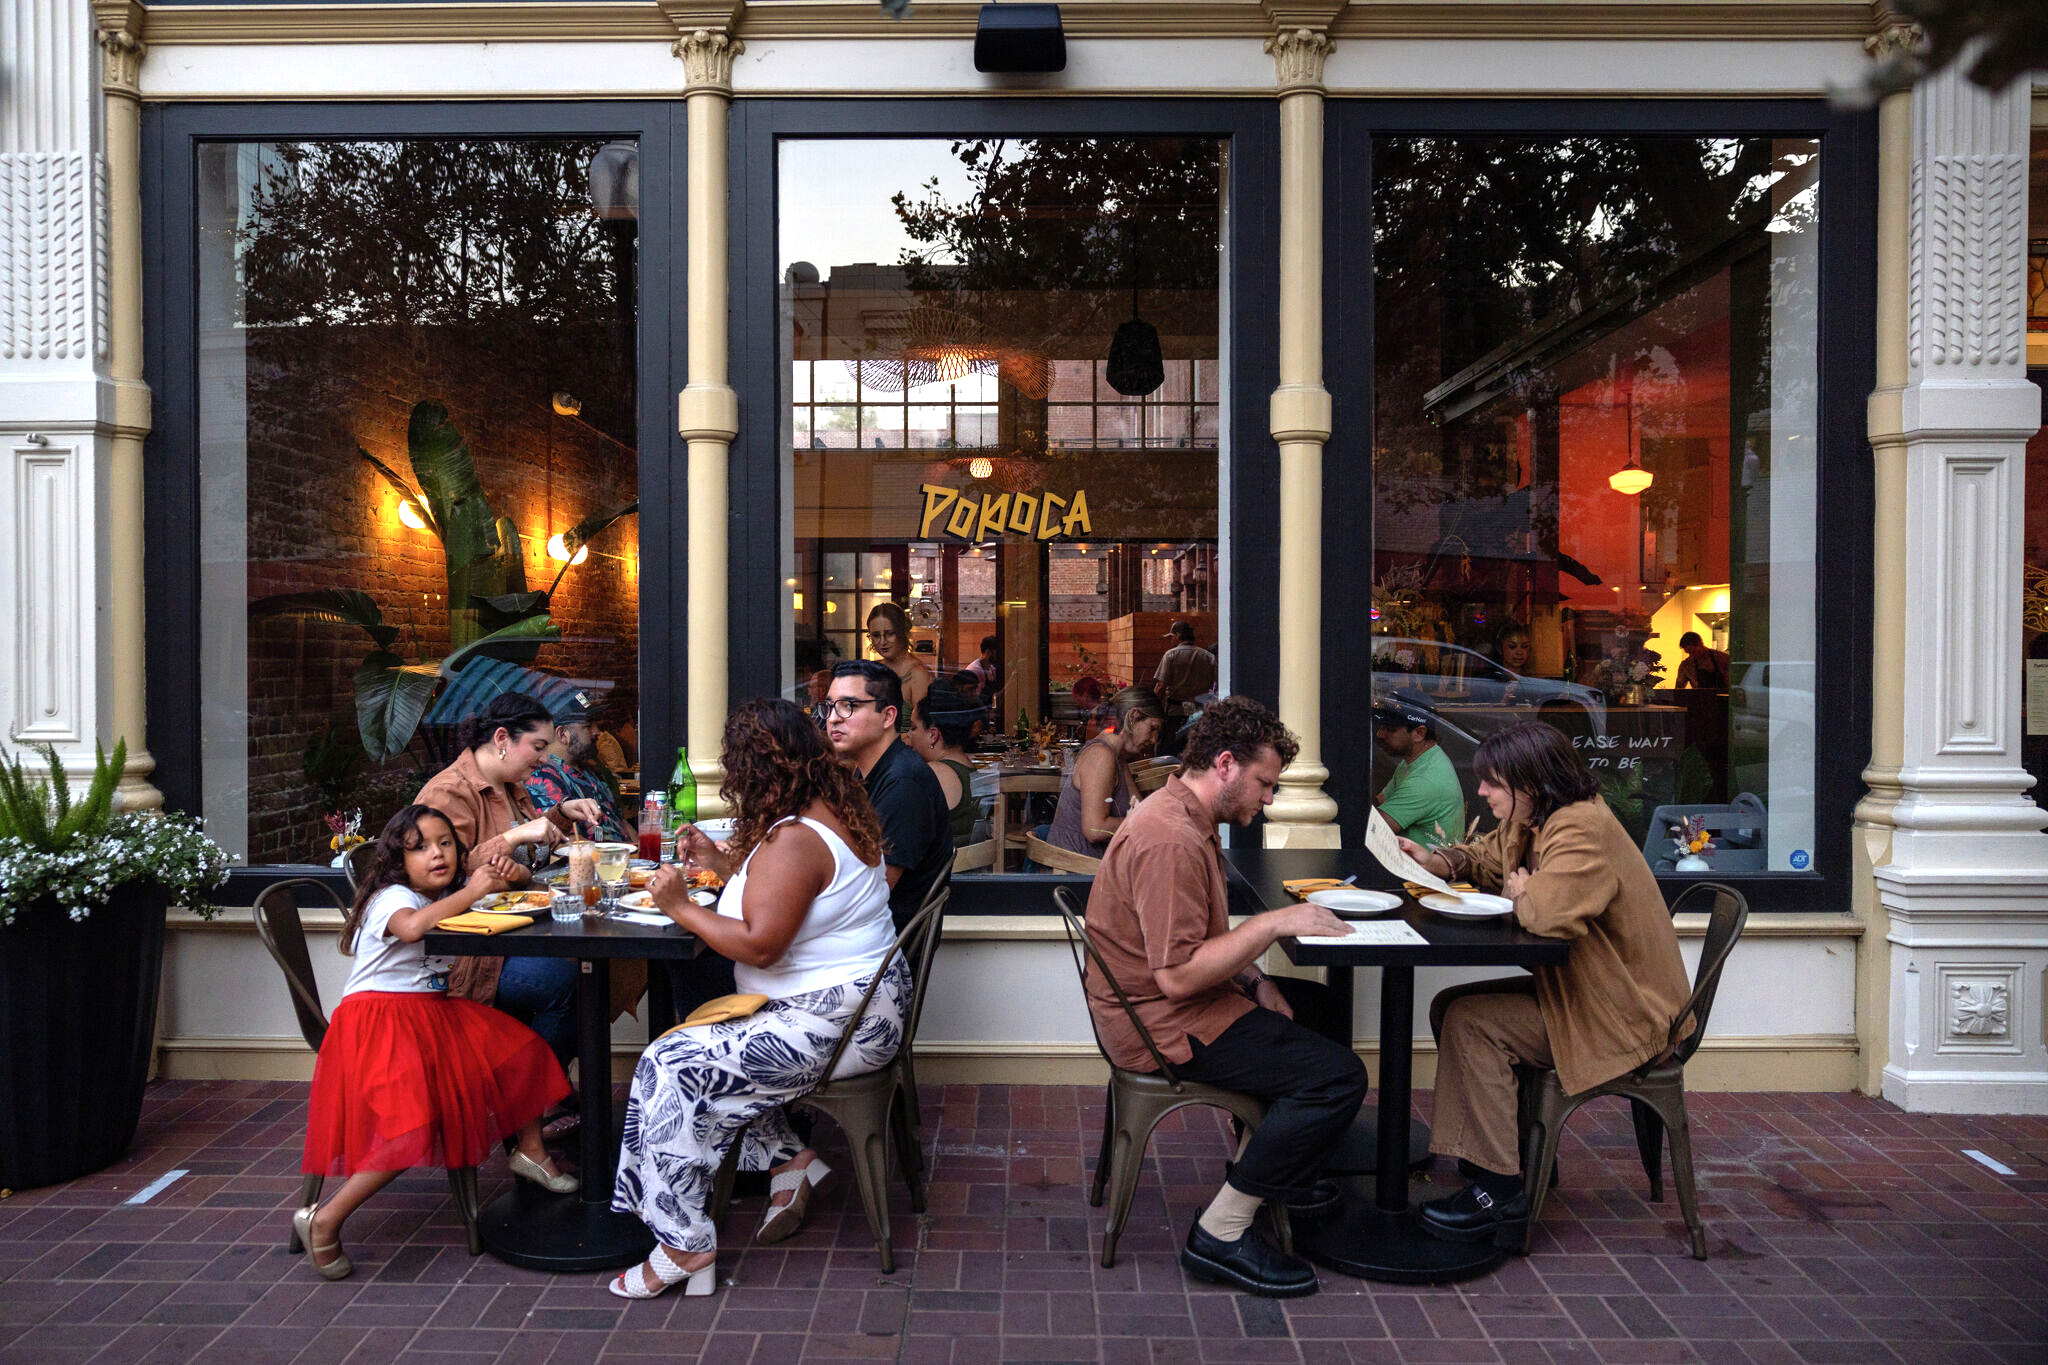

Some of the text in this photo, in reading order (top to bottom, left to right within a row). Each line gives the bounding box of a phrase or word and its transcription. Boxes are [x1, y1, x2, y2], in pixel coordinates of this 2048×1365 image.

[1572, 735, 1673, 749] EASE WAIT
[1588, 756, 1641, 770] TO BE
[1792, 855, 1808, 863] ADT
